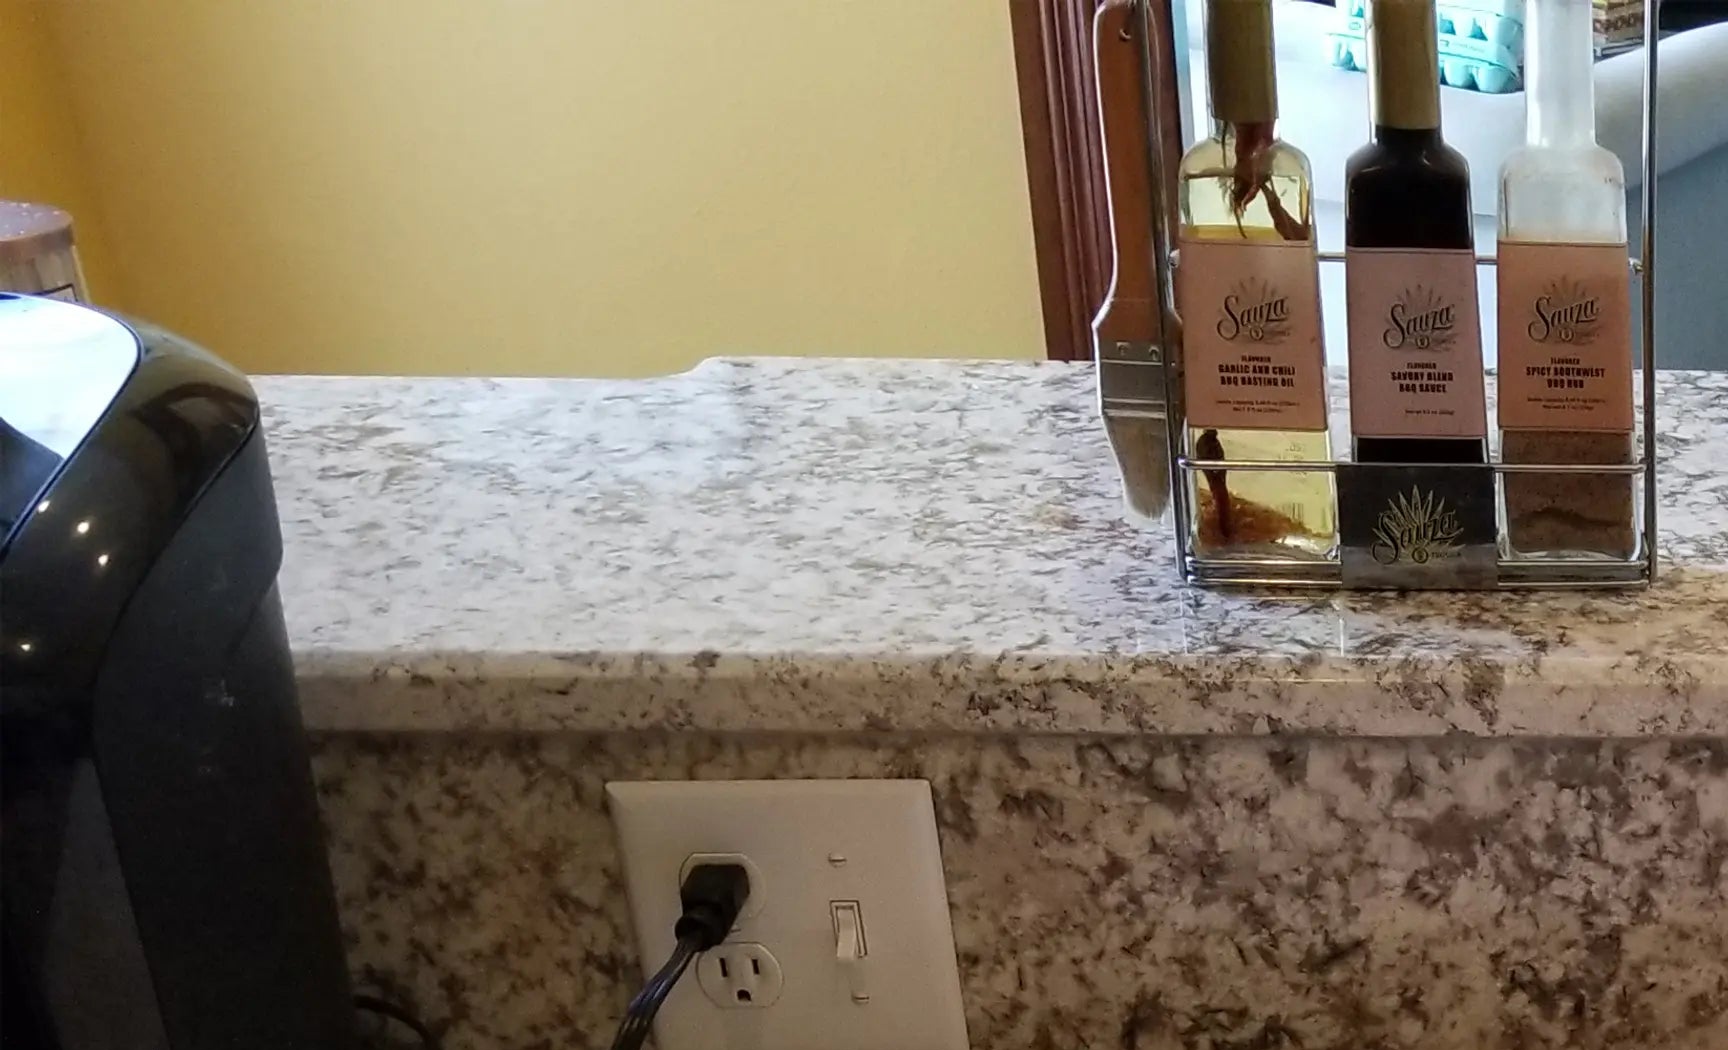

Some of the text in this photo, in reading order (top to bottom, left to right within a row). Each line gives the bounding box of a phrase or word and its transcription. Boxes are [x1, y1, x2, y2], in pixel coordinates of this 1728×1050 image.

[1217, 295, 1288, 341] Sauza
[1528, 296, 1599, 342] Sauza
[1383, 303, 1454, 348] Sauza
[1218, 364, 1296, 376] GARLIC AND CHILI
[1526, 366, 1605, 378] SPICY SOUTHWEST
[1220, 376, 1295, 387] BBQ BASTING OIL
[1391, 371, 1454, 382] SAVORY BLEND
[1399, 383, 1447, 394] BBQ SAUCE
[1547, 379, 1584, 389] BBQ RUB
